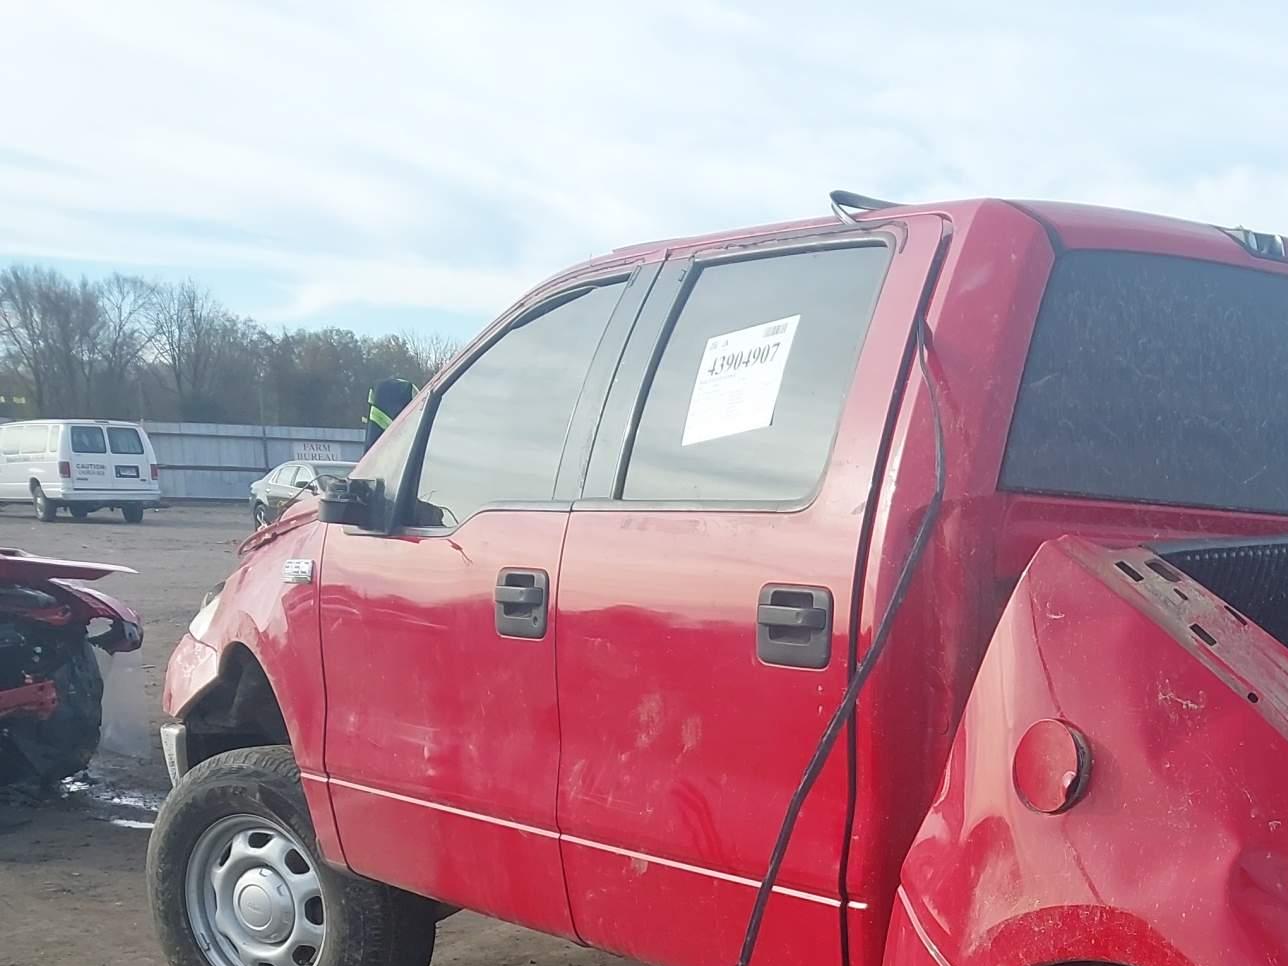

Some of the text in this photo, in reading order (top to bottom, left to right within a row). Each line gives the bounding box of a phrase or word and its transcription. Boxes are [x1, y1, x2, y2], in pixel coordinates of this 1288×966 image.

[707, 341, 781, 376] 43904907
[303, 443, 331, 452] FARM
[297, 452, 337, 461] BUREAU
